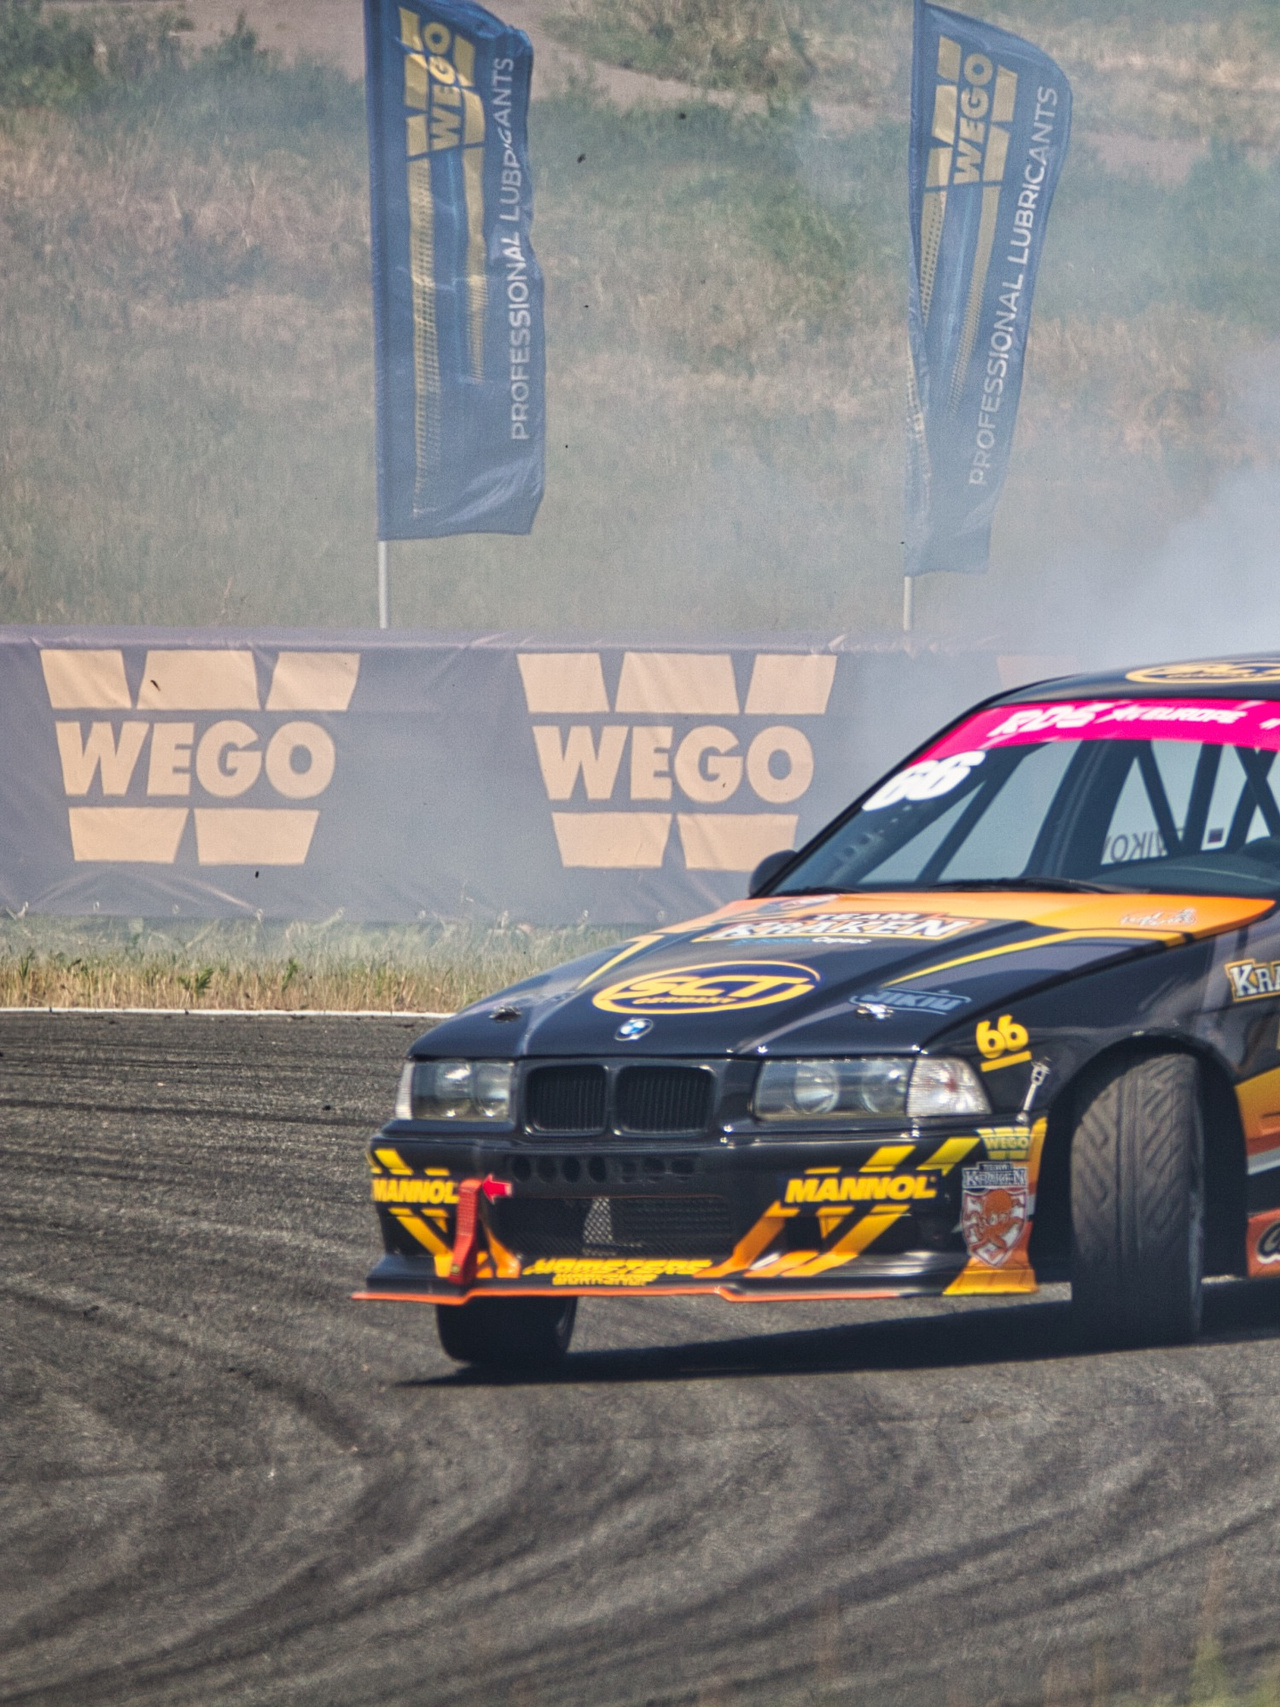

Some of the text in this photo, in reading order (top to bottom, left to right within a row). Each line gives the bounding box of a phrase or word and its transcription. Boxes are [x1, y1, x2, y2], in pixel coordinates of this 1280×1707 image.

[423, 21, 462, 153] WEGO
[953, 53, 993, 185] WEGO
[969, 86, 1058, 487] PROFESSIONAL LUBRICANTS
[501, 231, 533, 442] PROFESSIONAL
[986, 703, 1114, 737] RDS
[55, 720, 336, 798] WEGO
[532, 725, 815, 803] WEGO
[710, 919, 971, 939] KRAKEN
[600, 975, 810, 999] SCT
[976, 1014, 1029, 1059] 66
[372, 1178, 459, 1204] MANNOL
[784, 1176, 937, 1203] MANNOL
